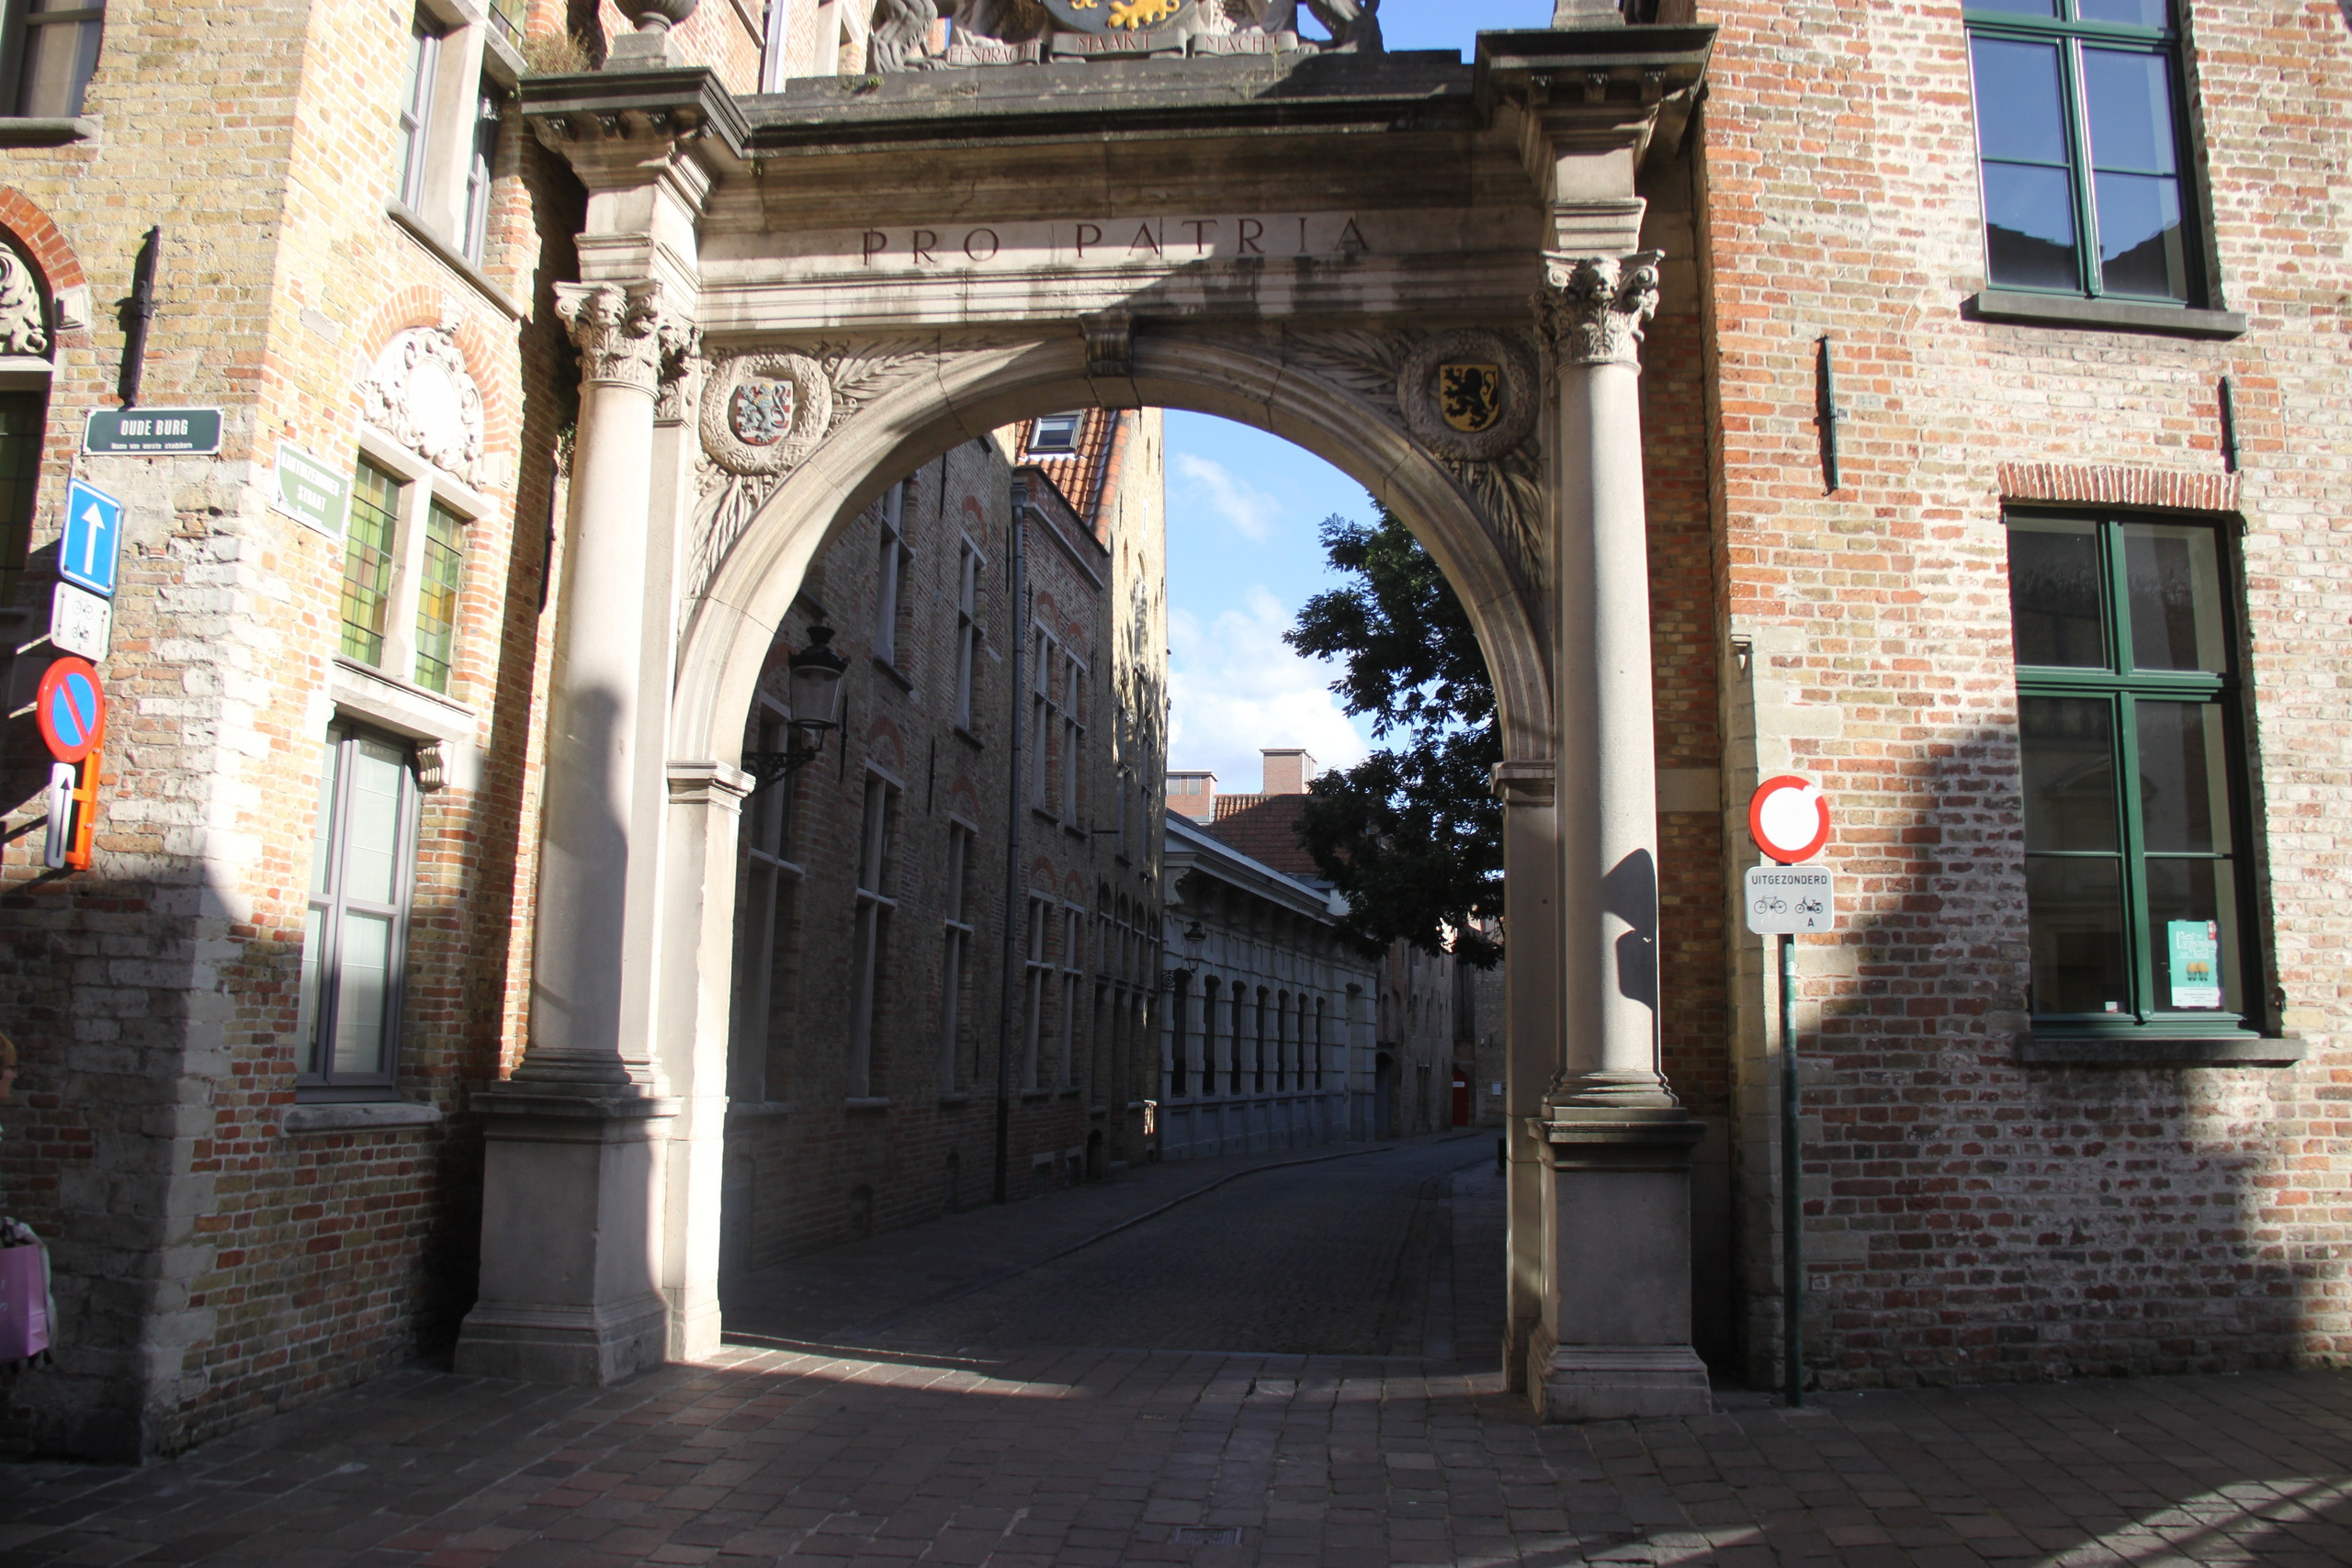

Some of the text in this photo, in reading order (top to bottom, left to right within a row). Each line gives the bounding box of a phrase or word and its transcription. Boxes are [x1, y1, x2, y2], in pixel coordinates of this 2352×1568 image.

[949, 33, 1283, 63] EENDRACHT MAAKT MACHT
[862, 216, 1370, 265] PRO PATRIA
[120, 419, 189, 436] OUDE BURG
[297, 484, 326, 513] STRAAT
[1751, 874, 1827, 885] UITGEZONDERD
[1807, 917, 1815, 928] A
